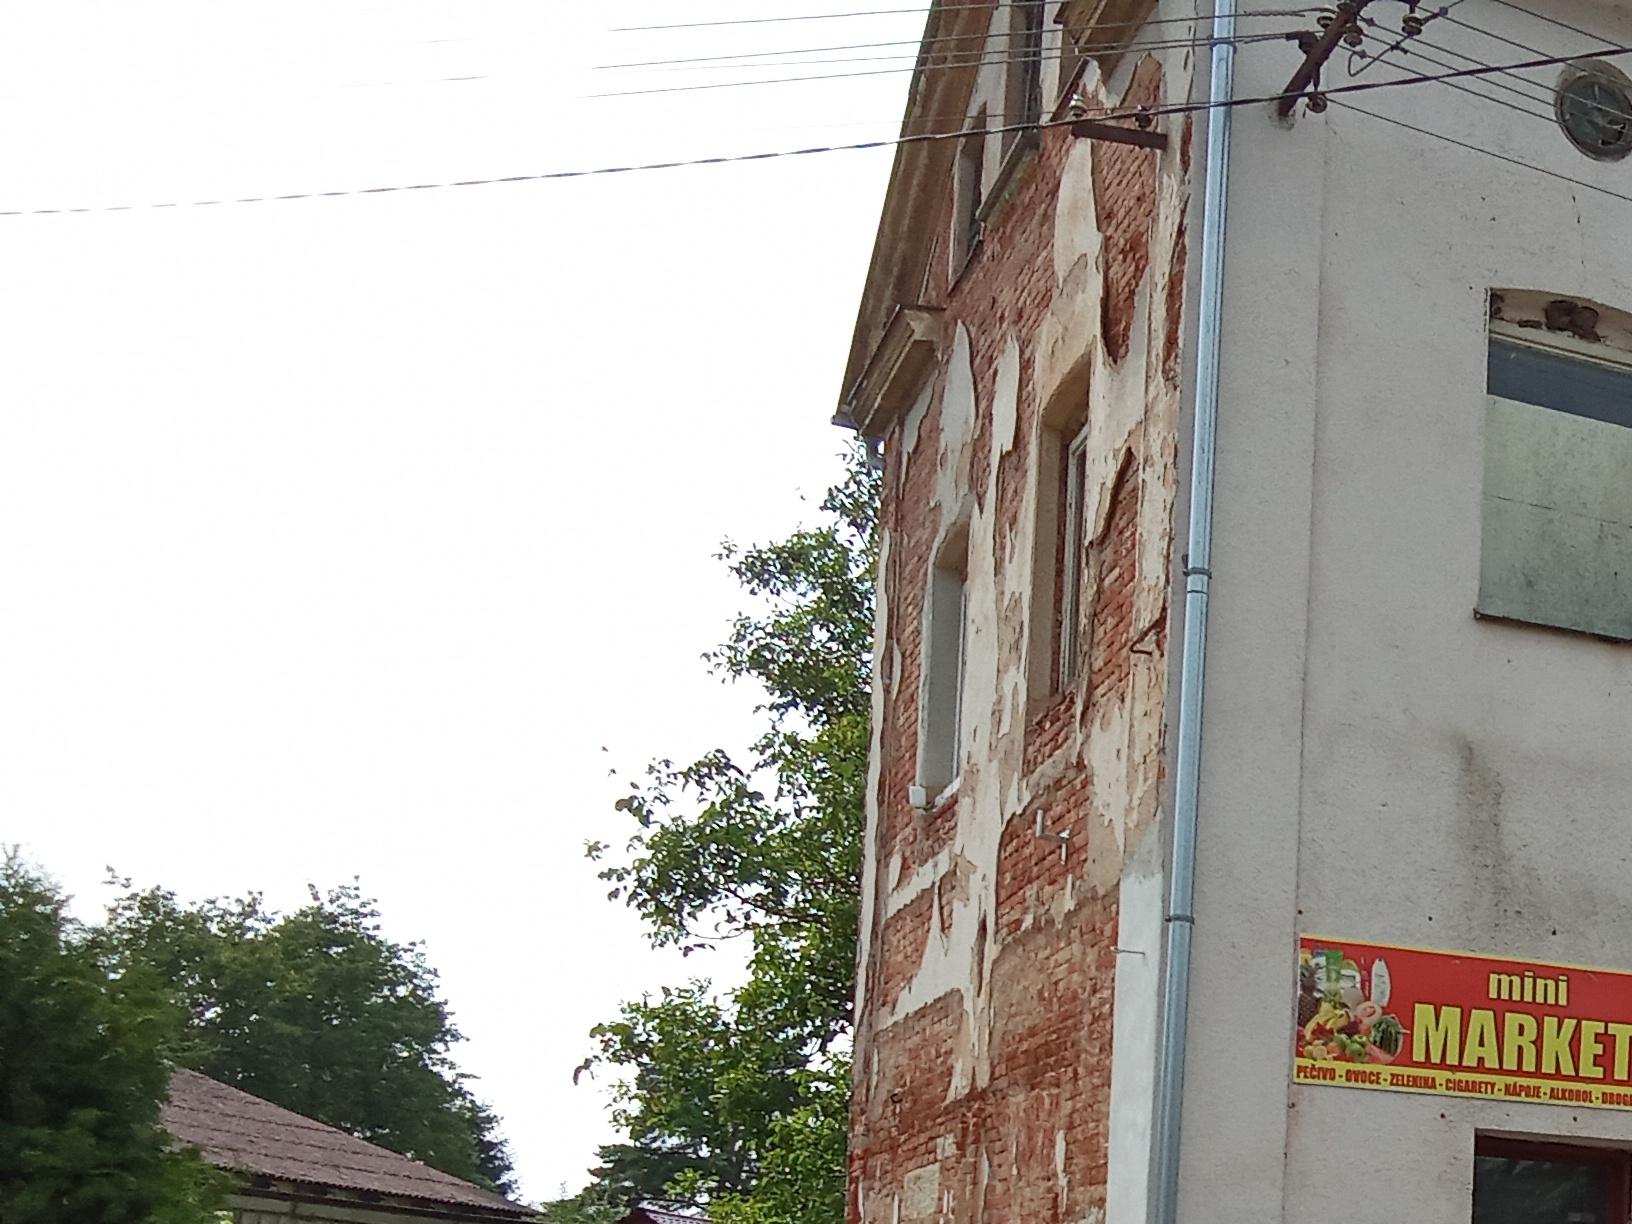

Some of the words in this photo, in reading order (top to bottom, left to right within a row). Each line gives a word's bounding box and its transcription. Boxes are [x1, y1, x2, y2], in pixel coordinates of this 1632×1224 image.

[1488, 971, 1568, 1006] mini
[1296, 1064, 1336, 1081] PEČIVO
[1345, 1069, 1382, 1085] OVOCE
[1389, 1073, 1438, 1089] ZELENINA
[1445, 1078, 1496, 1095] CIGARETY
[1504, 1083, 1542, 1098] NÁPOJE
[1549, 1087, 1594, 1103] ALKOHOL
